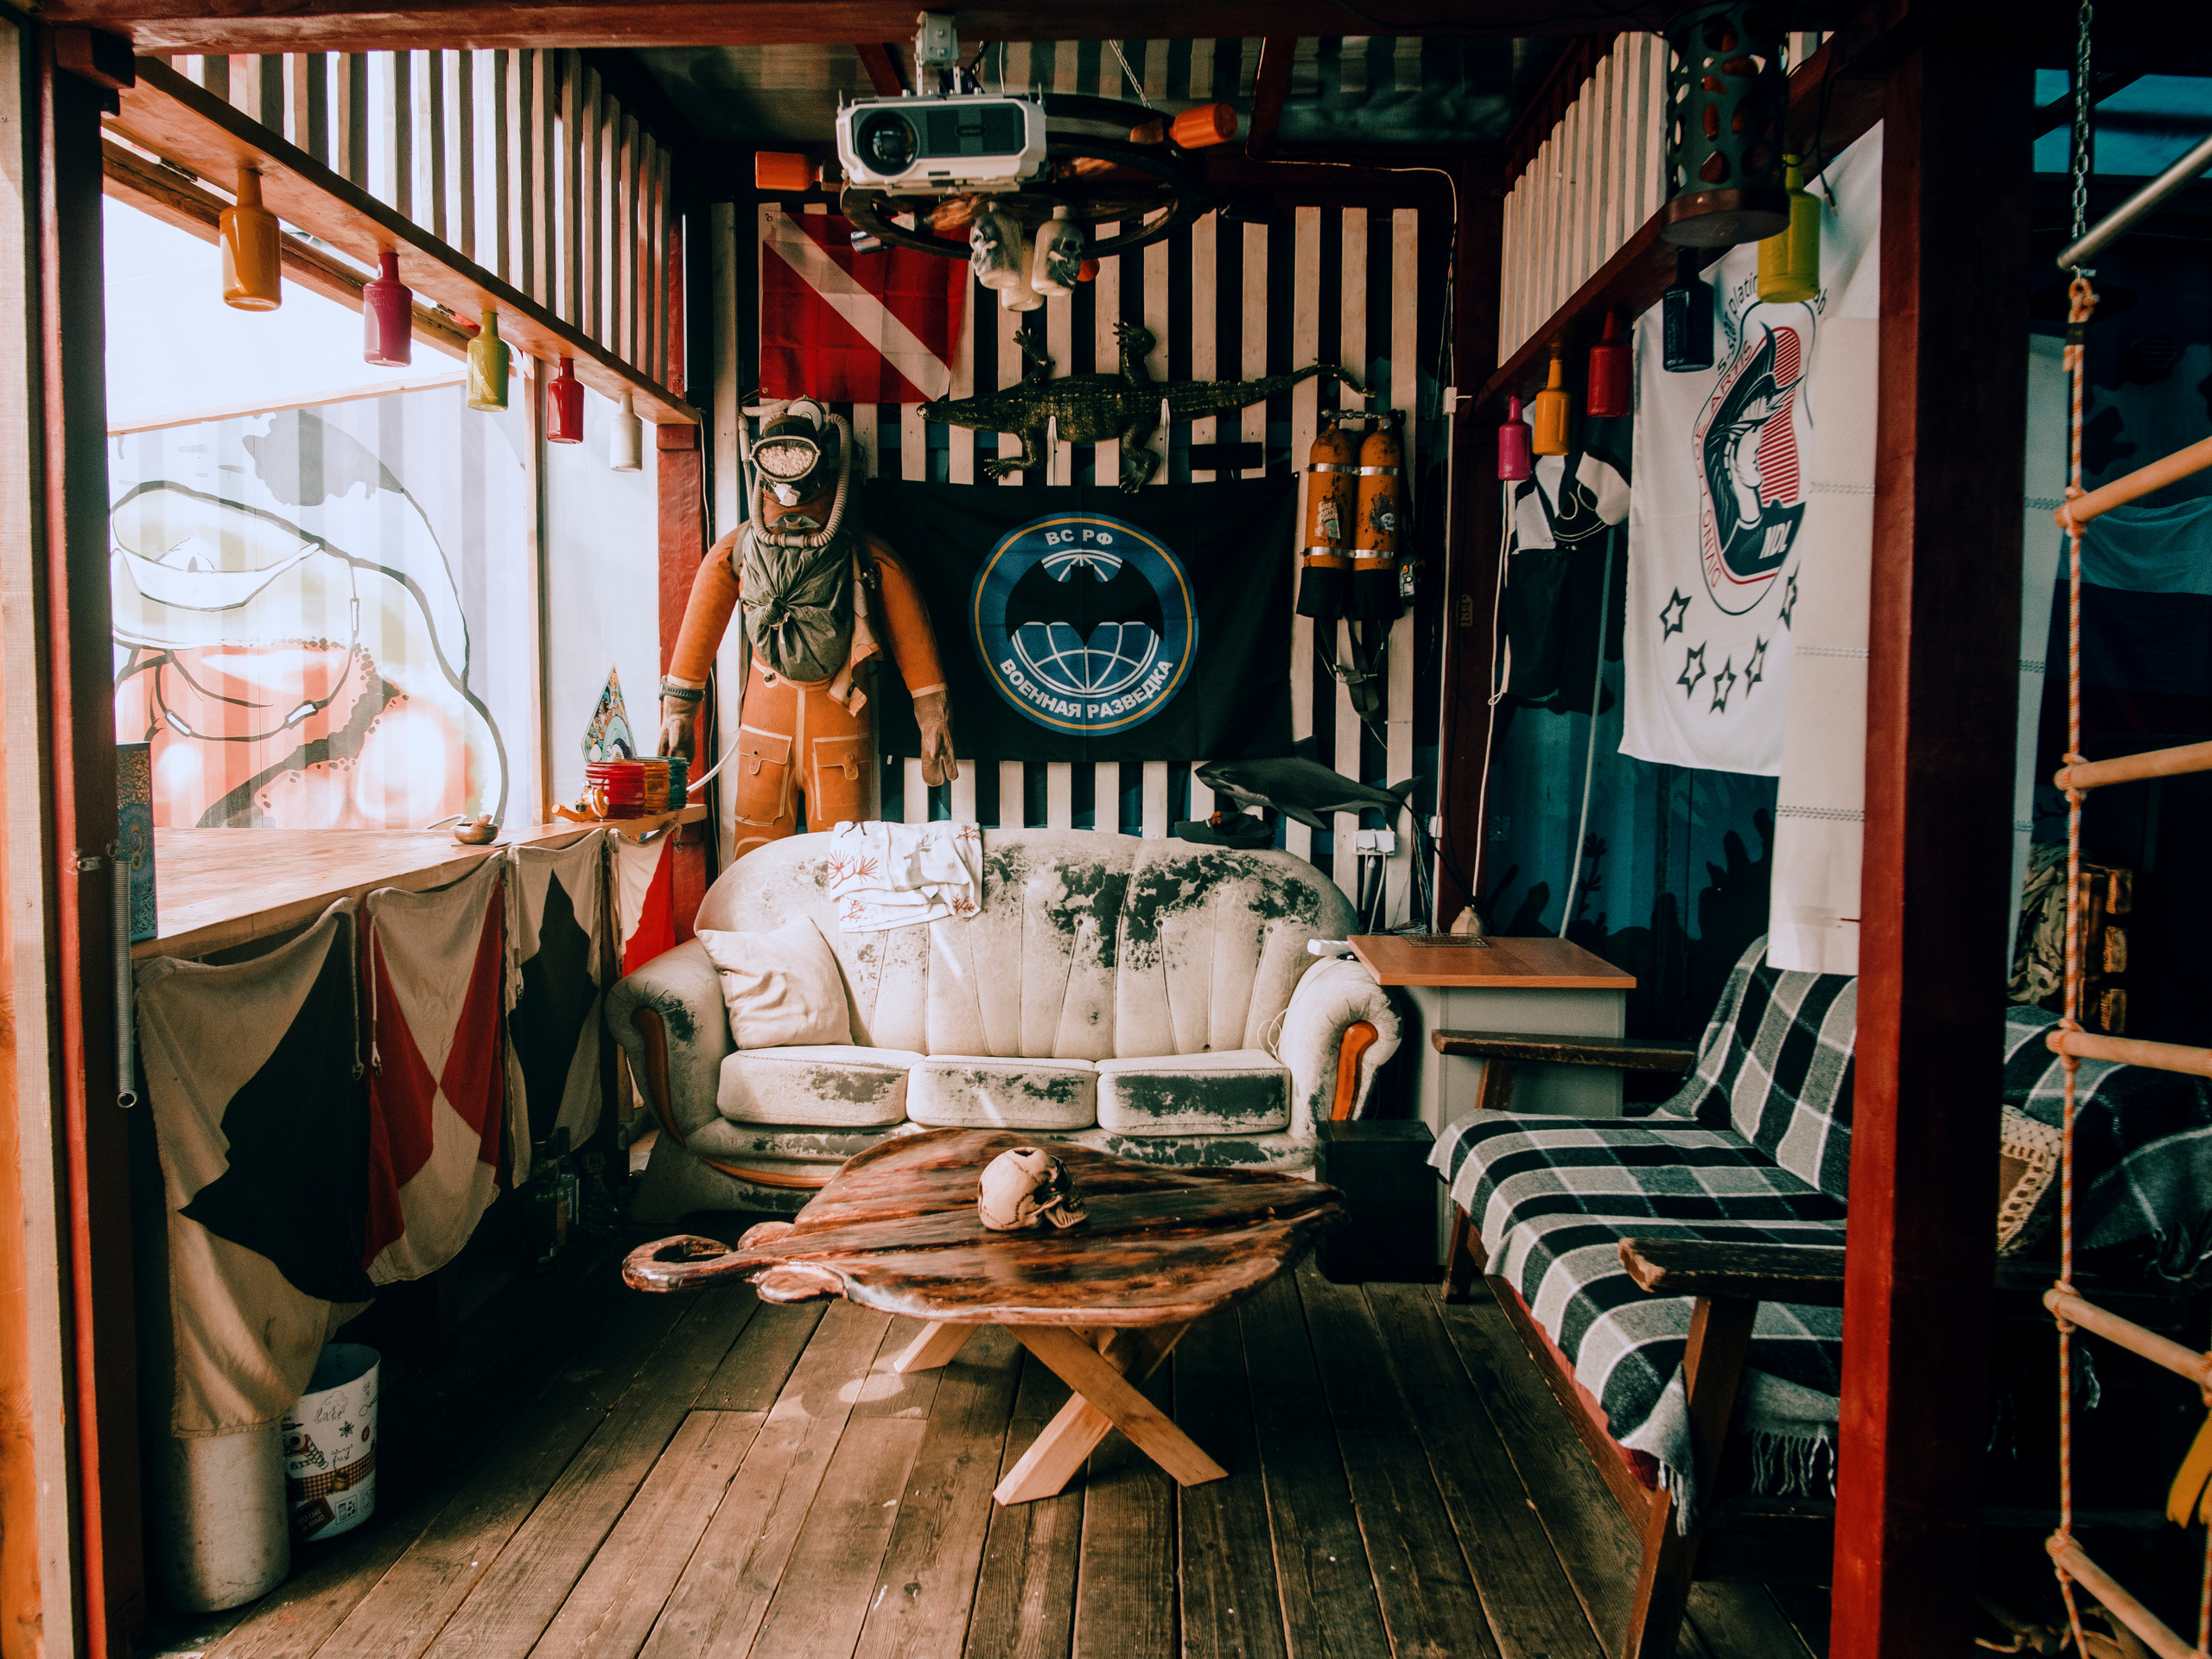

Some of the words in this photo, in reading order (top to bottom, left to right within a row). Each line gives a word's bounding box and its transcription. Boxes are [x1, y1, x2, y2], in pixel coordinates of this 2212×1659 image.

[1045, 529, 1075, 545] ВС
[1082, 529, 1114, 545] РФ
[1702, 509, 1722, 588] DIVING
[999, 658, 1082, 718] ВОЕННАЯ
[1087, 659, 1174, 719] РАЗВЕДКА
